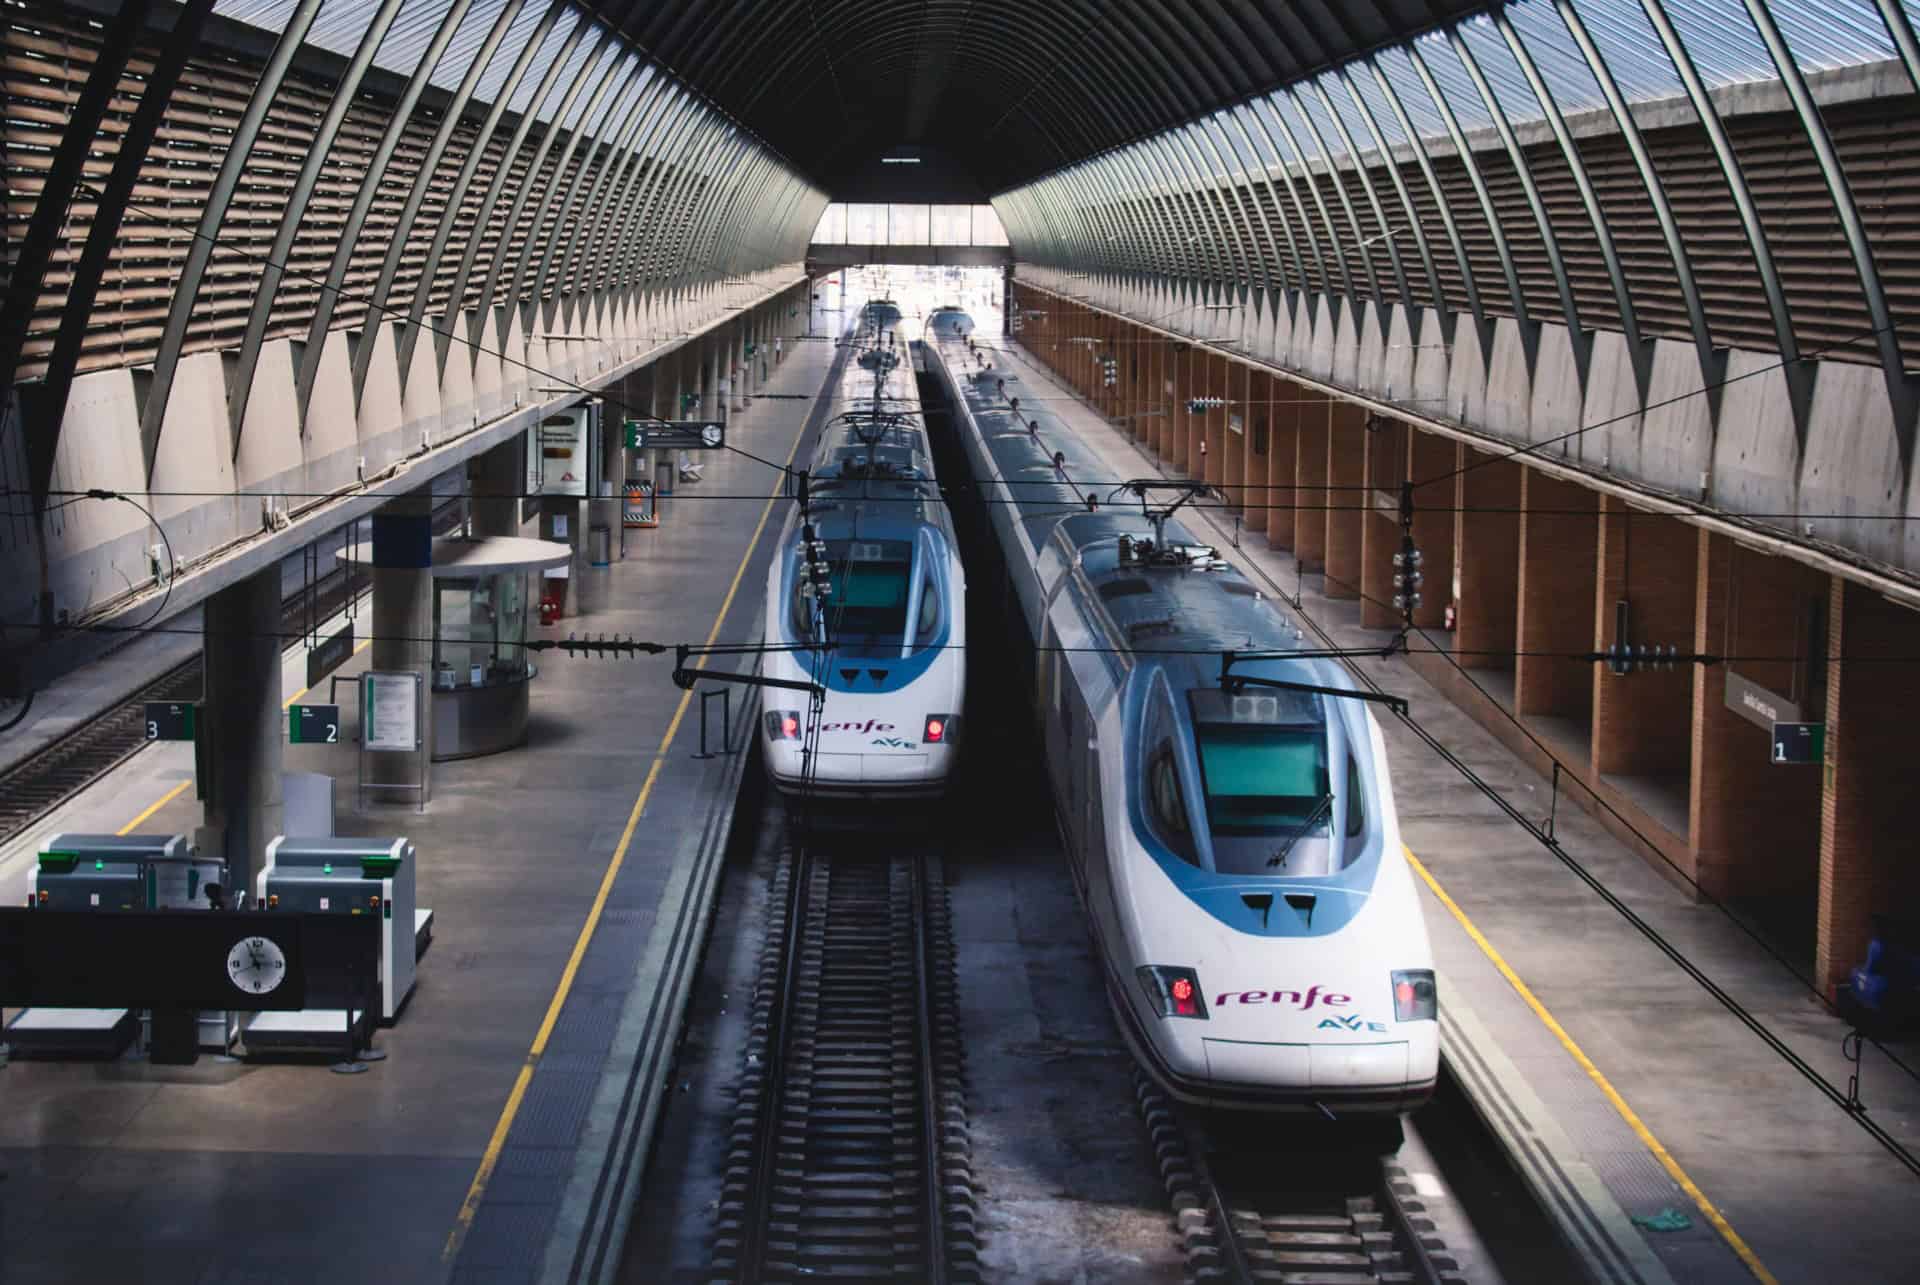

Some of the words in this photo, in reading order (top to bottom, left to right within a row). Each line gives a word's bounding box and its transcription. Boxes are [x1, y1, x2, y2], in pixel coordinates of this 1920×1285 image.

[634, 435, 642, 446] 2
[147, 721, 158, 738] 3
[326, 724, 337, 742] 2
[872, 737, 917, 749] AVE
[1775, 742, 1786, 761] 1
[1215, 985, 1352, 1011] renfe
[1317, 1014, 1387, 1032] AVE
